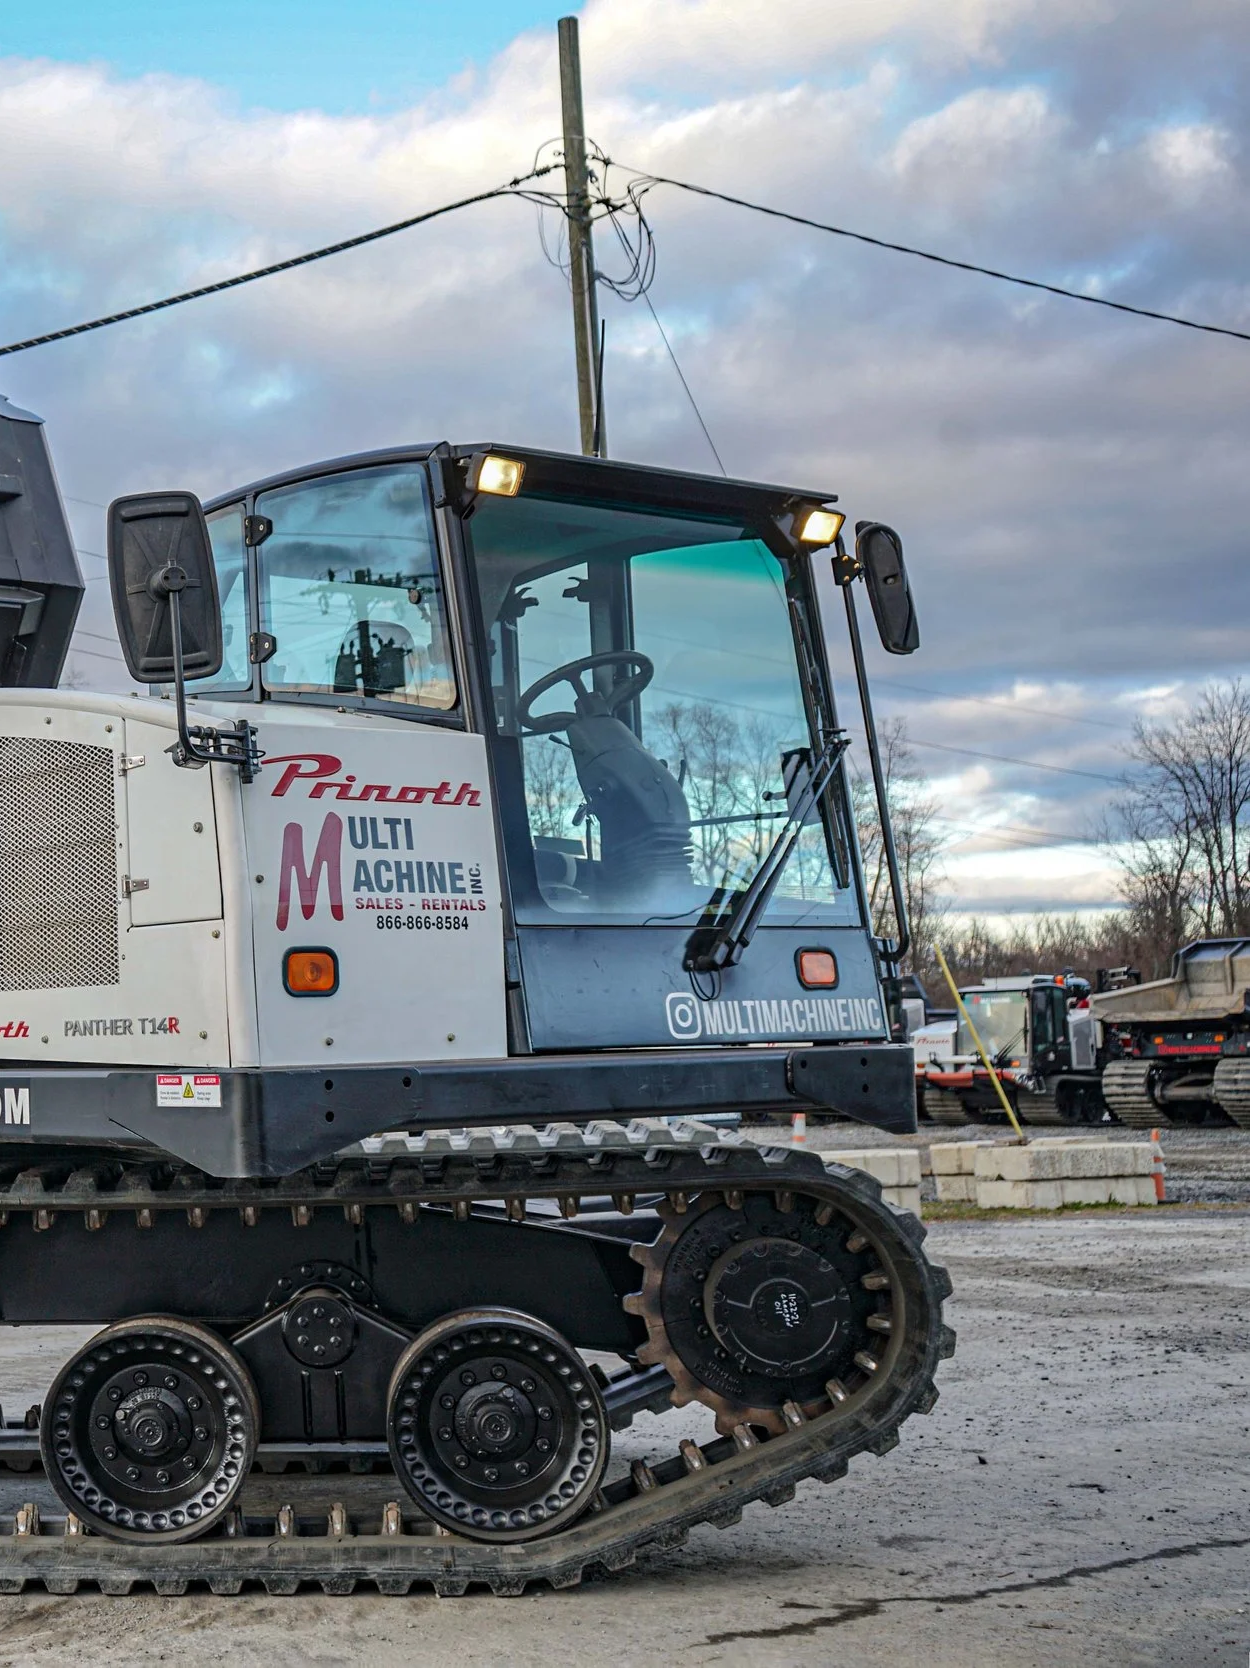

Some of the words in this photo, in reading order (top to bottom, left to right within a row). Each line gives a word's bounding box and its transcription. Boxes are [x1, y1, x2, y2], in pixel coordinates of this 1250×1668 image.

[261, 753, 481, 807] Prinoth
[469, 862, 484, 895] INC.
[355, 897, 403, 910] SALES
[421, 898, 487, 911] RENTALS
[376, 915, 469, 930] 866-866-8584
[64, 1018, 134, 1037] PANTHER
[138, 1016, 181, 1035] T14R
[702, 997, 882, 1036] MULTIMACHINEINC
